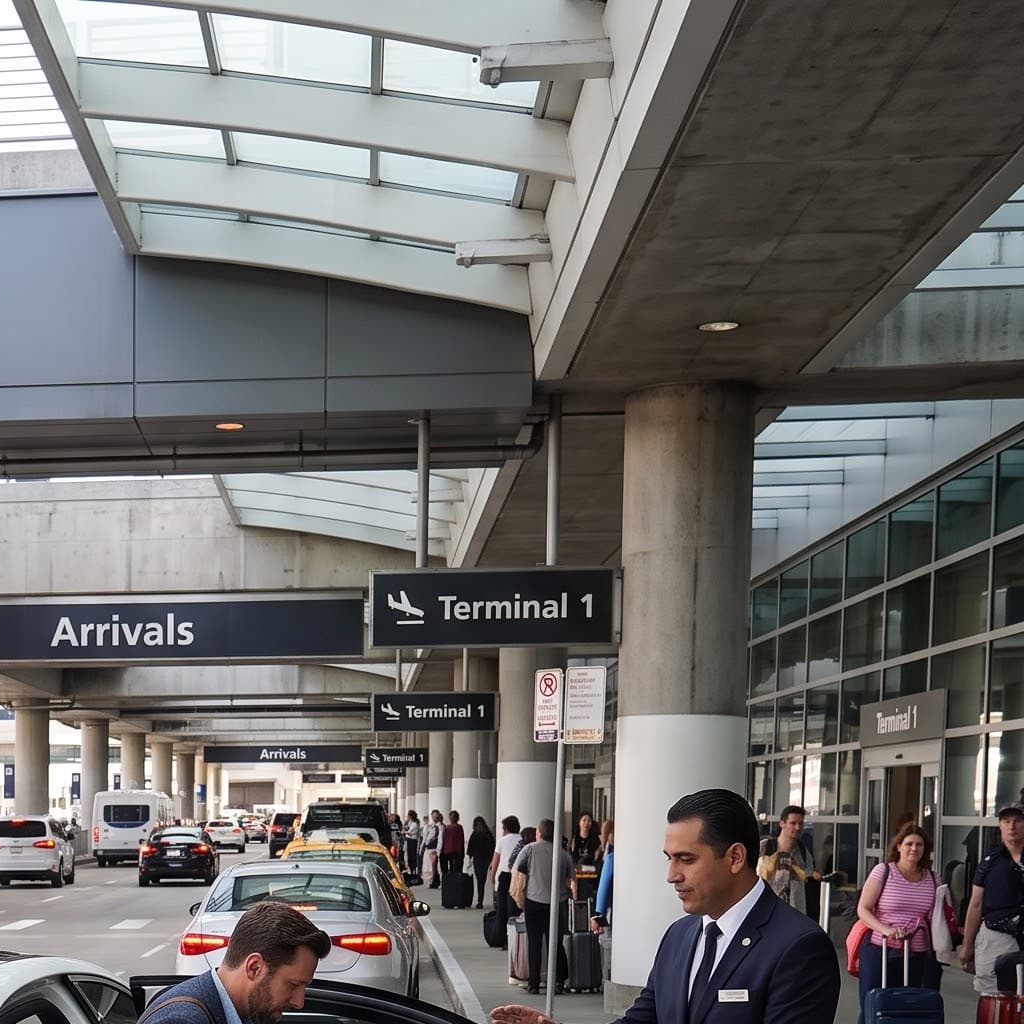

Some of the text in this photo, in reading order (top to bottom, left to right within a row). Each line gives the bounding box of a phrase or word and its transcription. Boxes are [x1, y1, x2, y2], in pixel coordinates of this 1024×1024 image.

[438, 592, 594, 621] Terminal 1
[50, 612, 195, 647] Arrivals
[406, 704, 486, 718] Terminal 1
[876, 704, 918, 734] Terminal 1
[259, 748, 307, 760] Arrivals
[419, 753, 424, 762] 1
